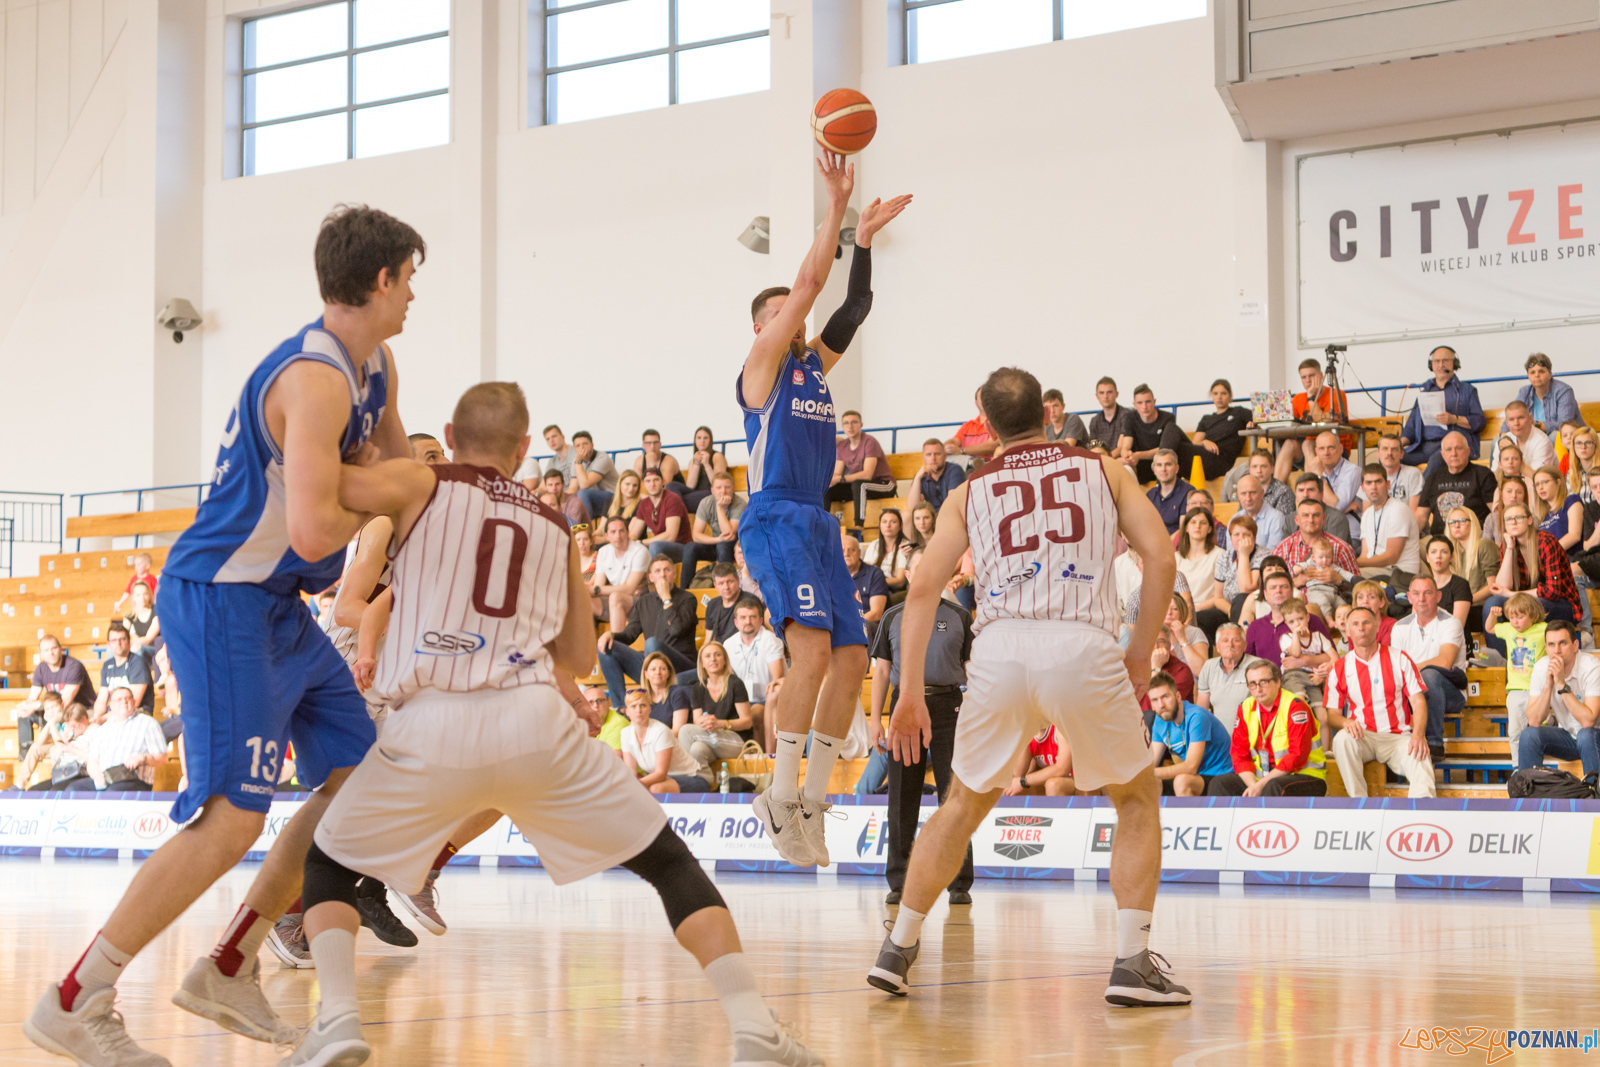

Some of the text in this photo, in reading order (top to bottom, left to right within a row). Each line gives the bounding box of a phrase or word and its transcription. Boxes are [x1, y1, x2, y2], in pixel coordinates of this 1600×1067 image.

[1420, 255, 1471, 274] WIĘCEJ
[1479, 252, 1503, 267] NIŻ
[1511, 249, 1549, 264] KLUB
[1003, 453, 1064, 469] STARGARD
[1004, 447, 1062, 463] SPÓJNIA
[991, 467, 1086, 558] 25
[472, 518, 528, 619] 0
[1070, 572, 1094, 581] OLIMP
[797, 583, 815, 610] 9
[1471, 684, 1477, 694] 9
[245, 736, 279, 782] 13
[0, 815, 39, 836] Znan
[138, 818, 162, 833] KIA
[1005, 816, 1043, 825] SECURITY
[1000, 828, 1042, 843] JOKER
[1161, 826, 1223, 851] CKEL
[1246, 829, 1288, 850] KIA
[1313, 830, 1376, 851] DELIK
[1397, 832, 1441, 853] KIA
[1468, 833, 1534, 855] DELIK
